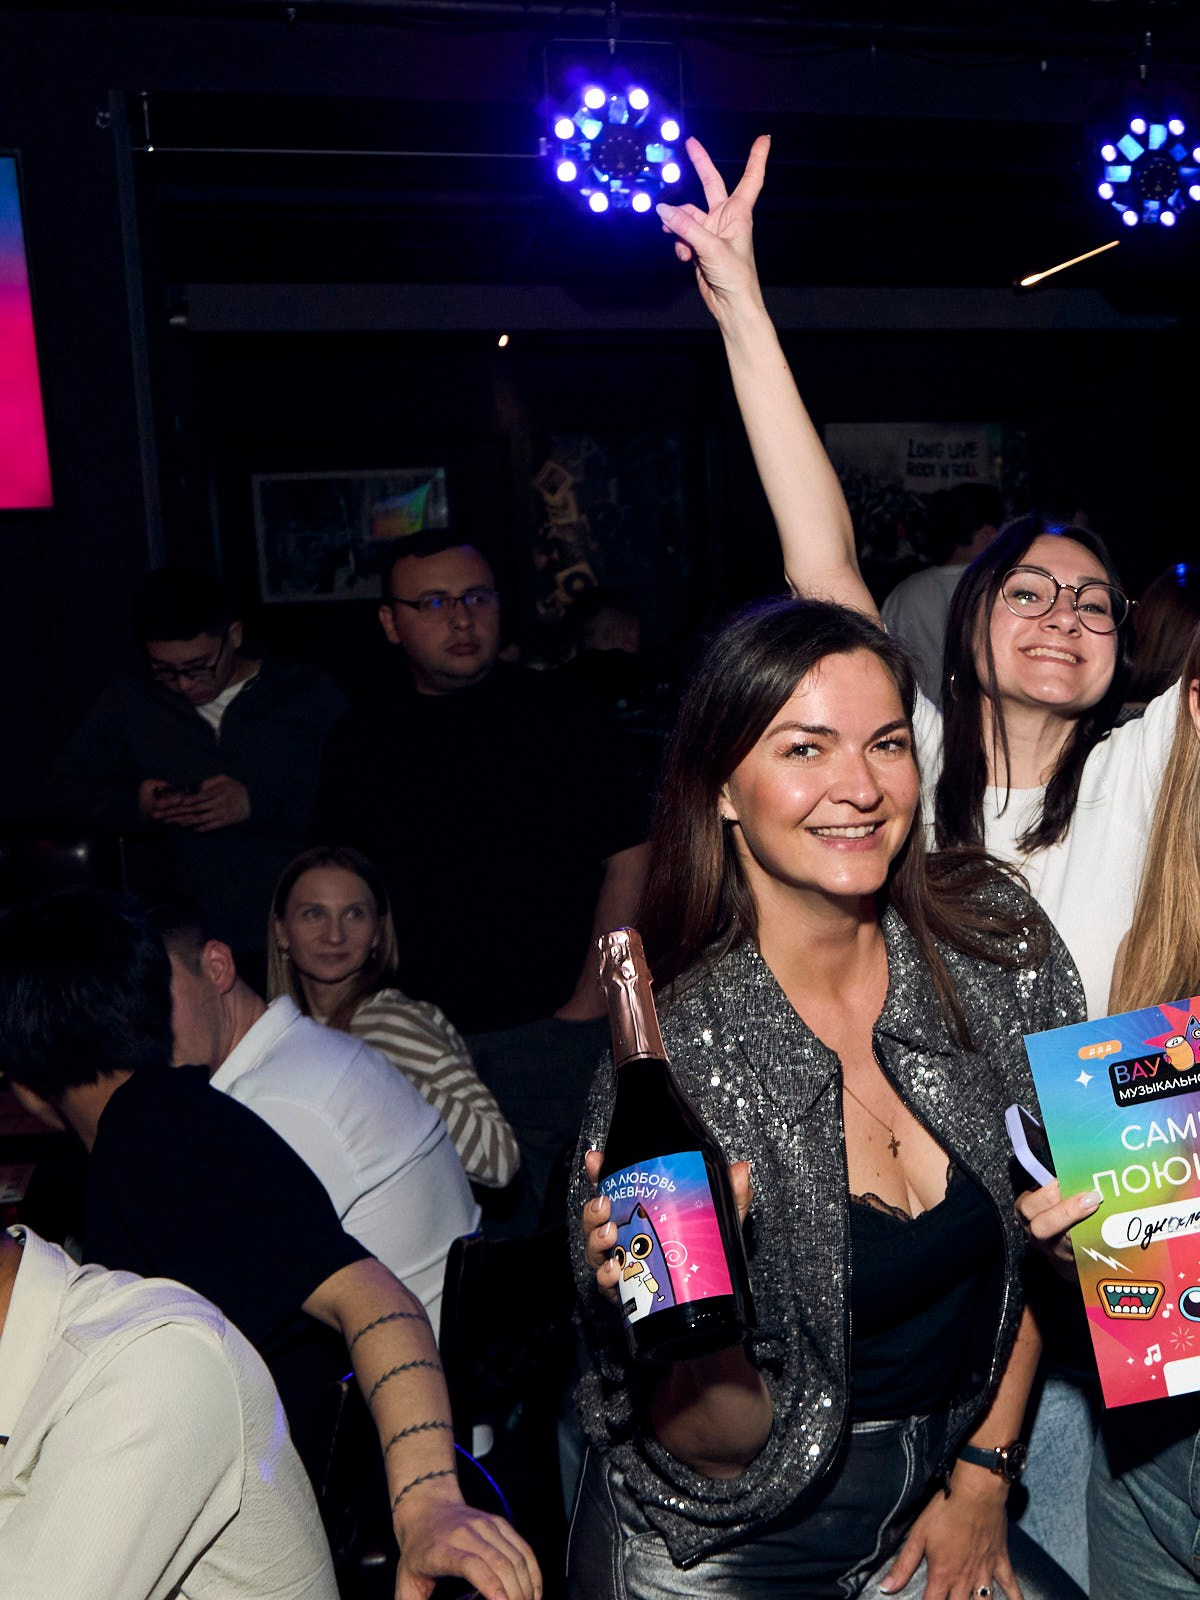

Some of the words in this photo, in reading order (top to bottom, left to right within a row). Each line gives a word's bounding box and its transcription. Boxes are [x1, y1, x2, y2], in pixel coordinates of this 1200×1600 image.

[908, 440, 945, 458] LONG
[949, 441, 977, 458] LIVE
[1114, 1057, 1161, 1084] ВАУ
[605, 1178, 617, 1192] ЗА
[618, 1172, 677, 1193] ЛЮБОВЬ
